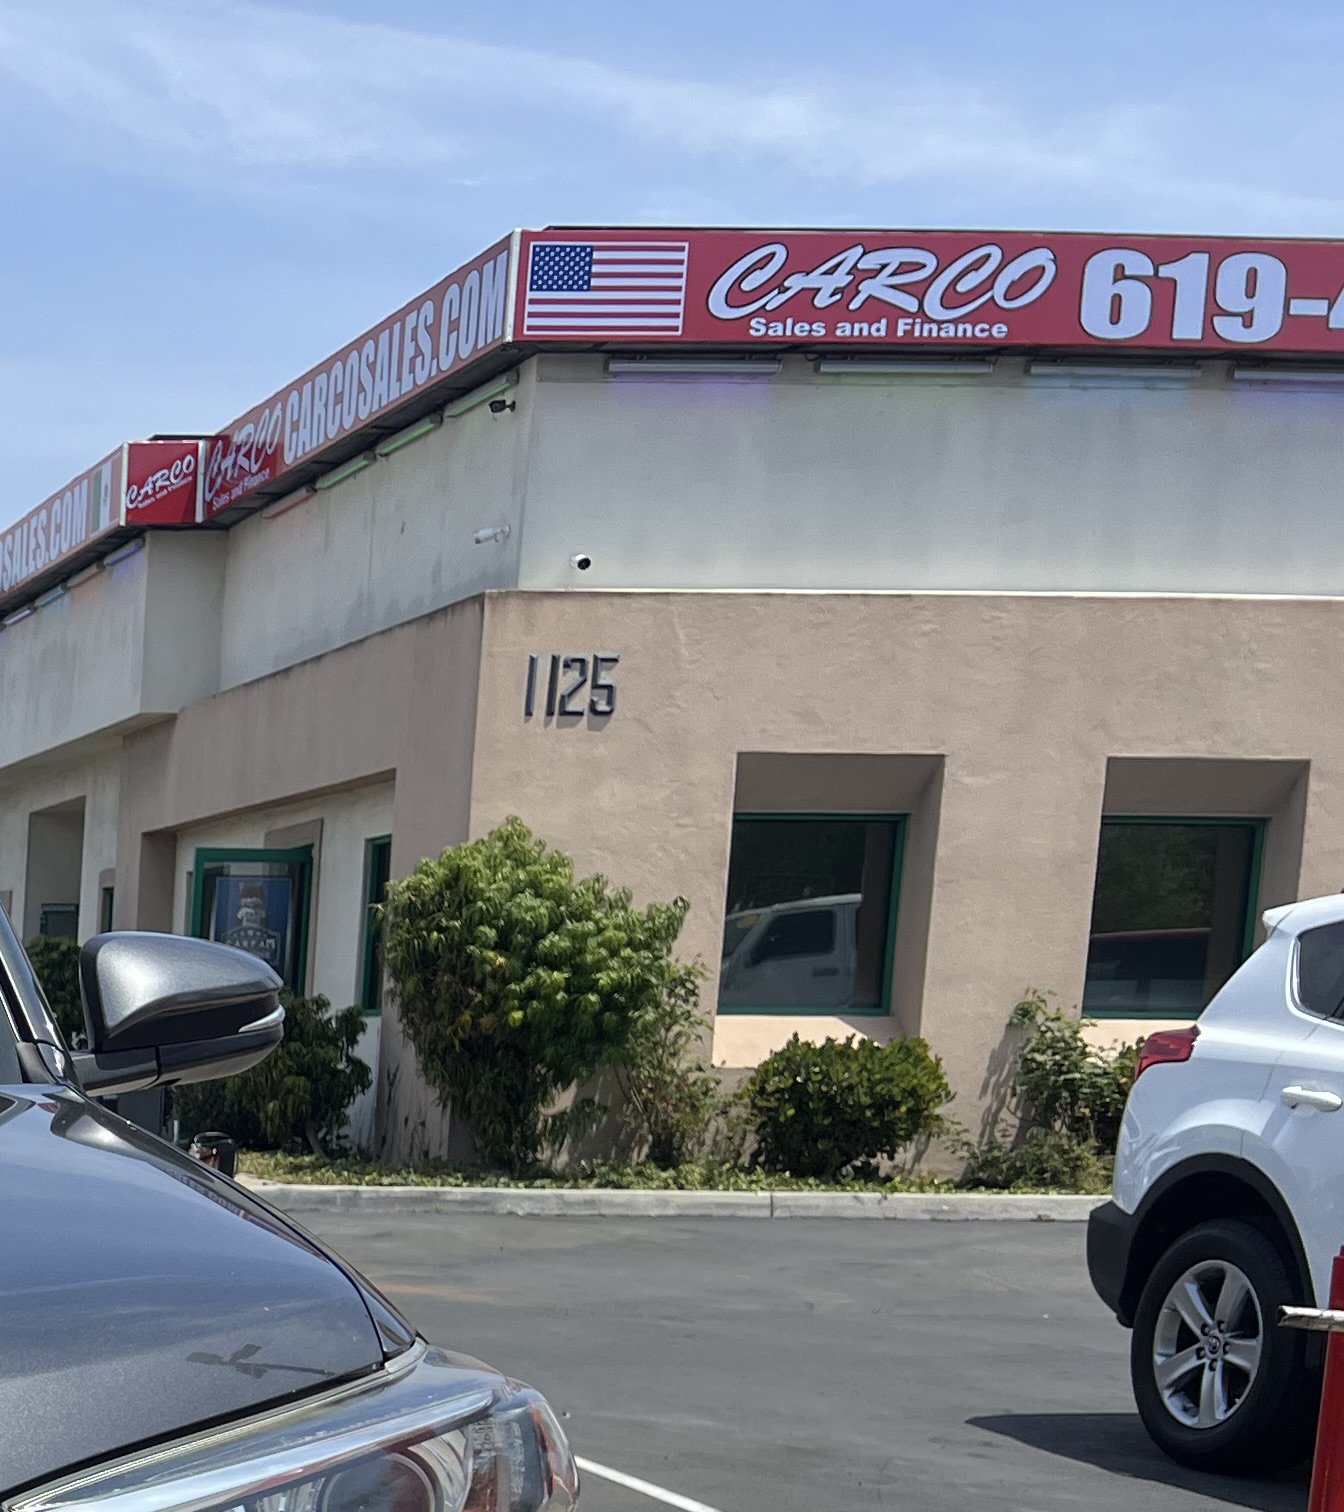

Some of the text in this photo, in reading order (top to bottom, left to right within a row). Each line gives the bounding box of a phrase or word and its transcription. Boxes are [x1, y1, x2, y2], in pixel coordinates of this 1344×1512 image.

[706, 242, 1344, 343] CARCO 619-
[749, 317, 1009, 339] Sales and Finance
[204, 249, 510, 502] CARCO CARCOSALES.COM
[126, 454, 195, 509] CARCO
[524, 653, 620, 718] 1125
